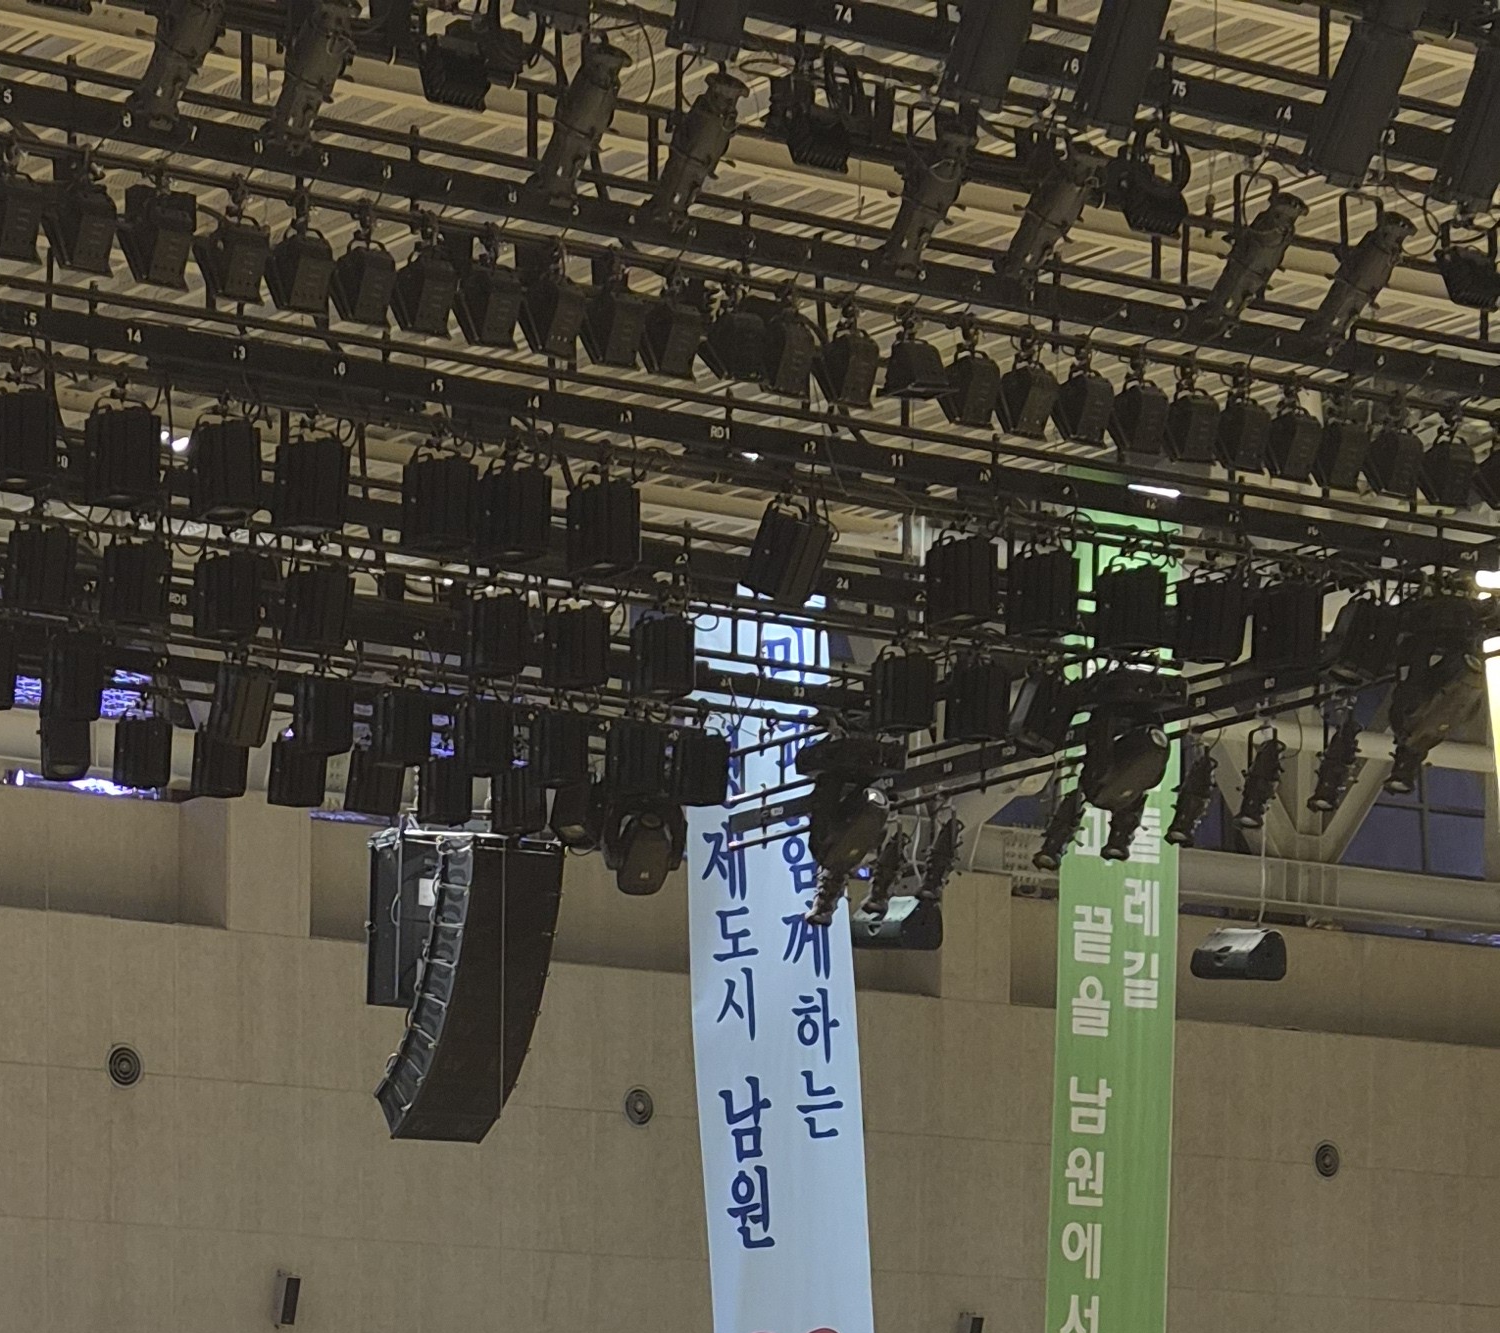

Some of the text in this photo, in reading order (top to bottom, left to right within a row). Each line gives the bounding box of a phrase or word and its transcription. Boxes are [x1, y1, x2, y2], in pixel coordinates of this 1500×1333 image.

[126, 328, 142, 343] 14
[1072, 905, 1113, 1037] 끝을
[718, 1075, 775, 1249] 남원
